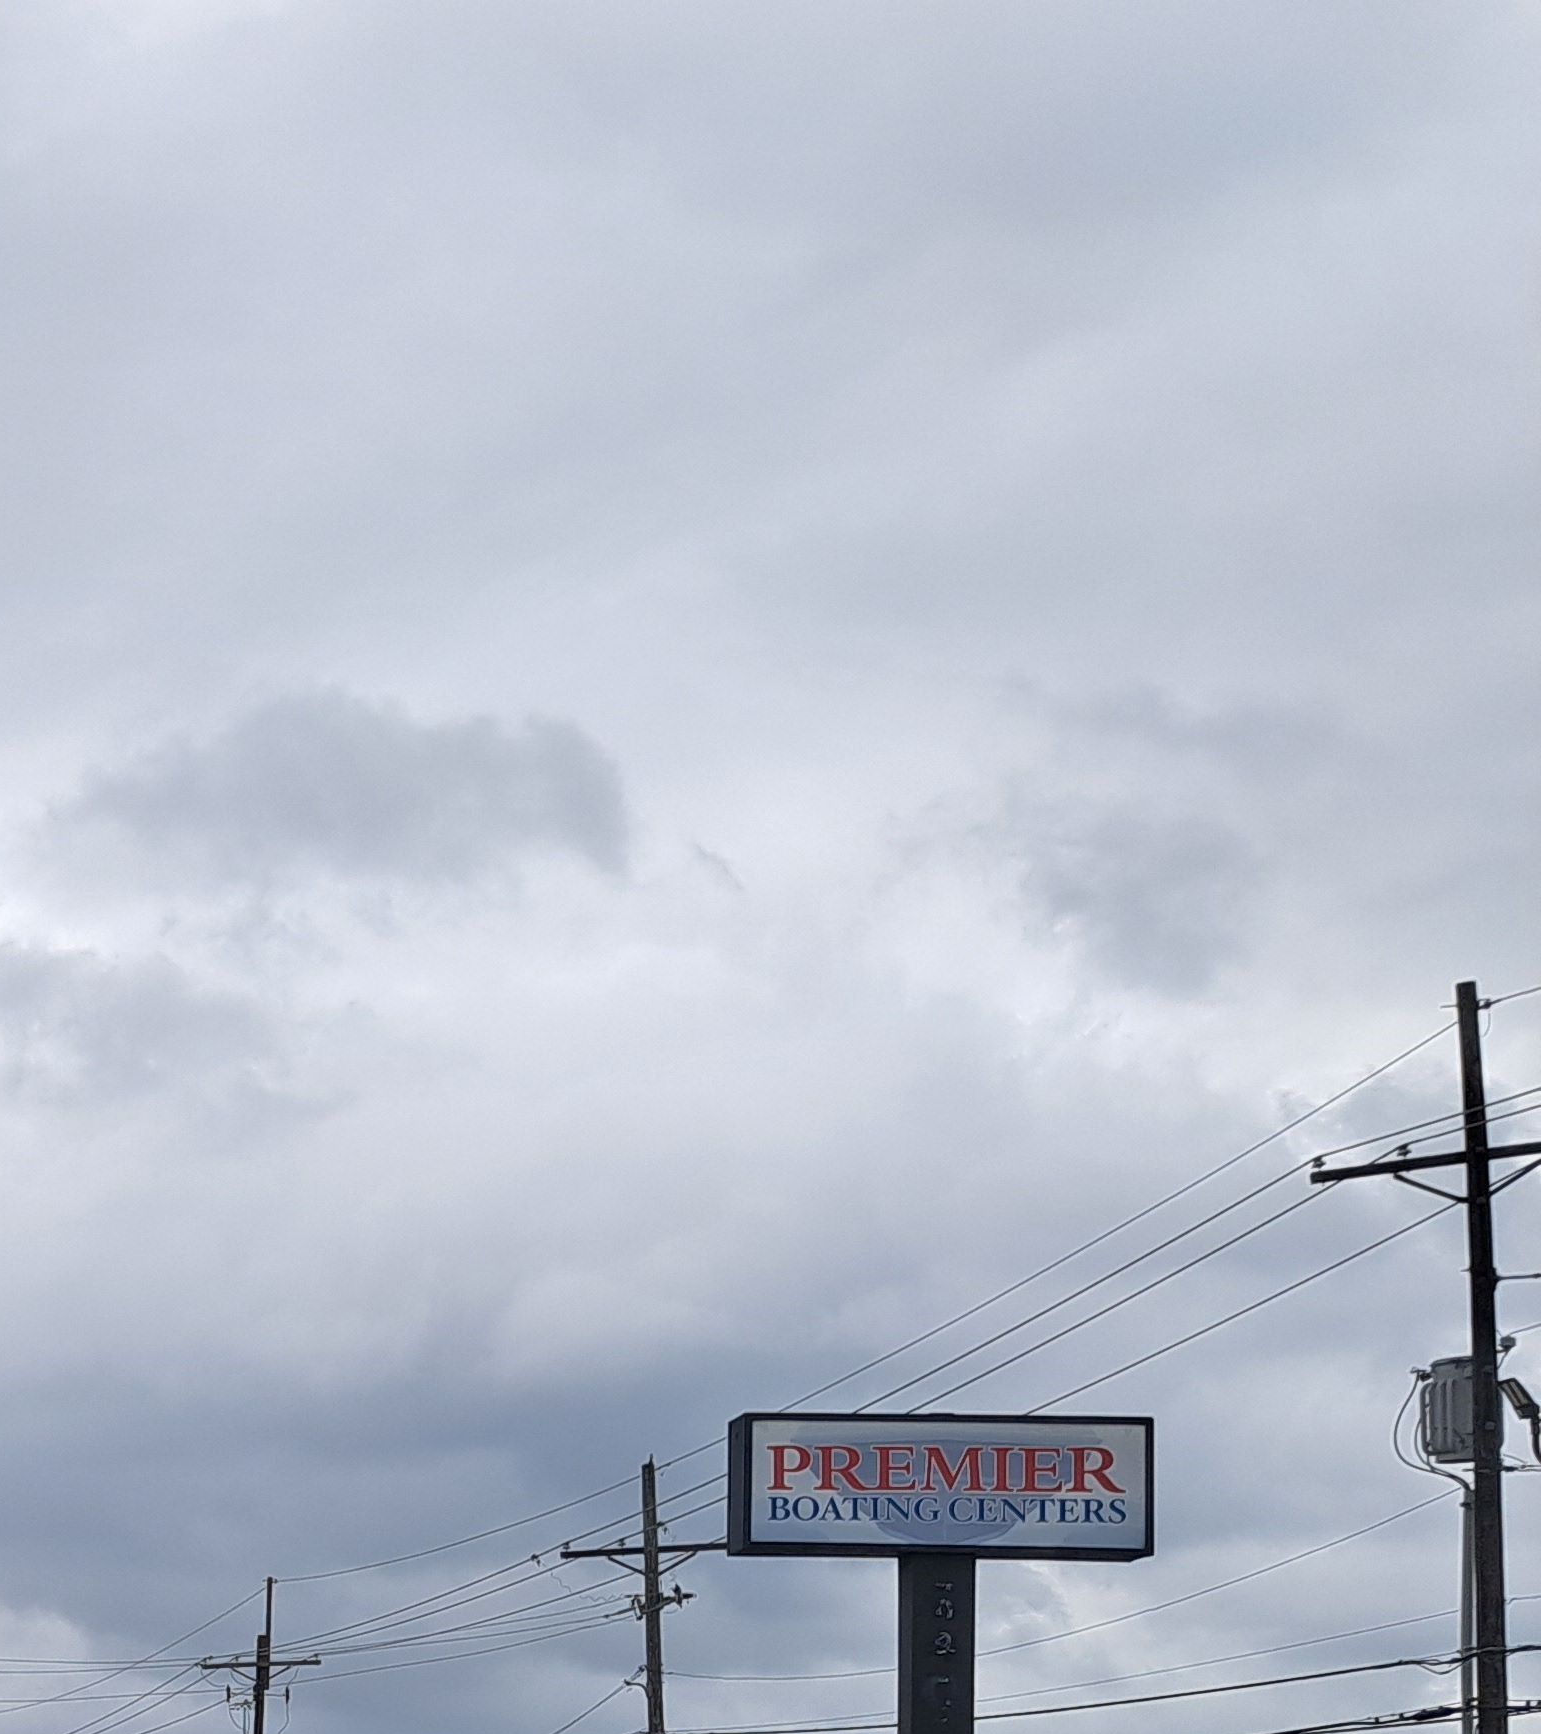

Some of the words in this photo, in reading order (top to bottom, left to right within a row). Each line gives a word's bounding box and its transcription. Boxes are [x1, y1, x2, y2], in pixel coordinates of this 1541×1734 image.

[766, 1445, 1127, 1494] PREMIER
[768, 1496, 939, 1524] BOATING
[948, 1499, 1128, 1525] CENTERS
